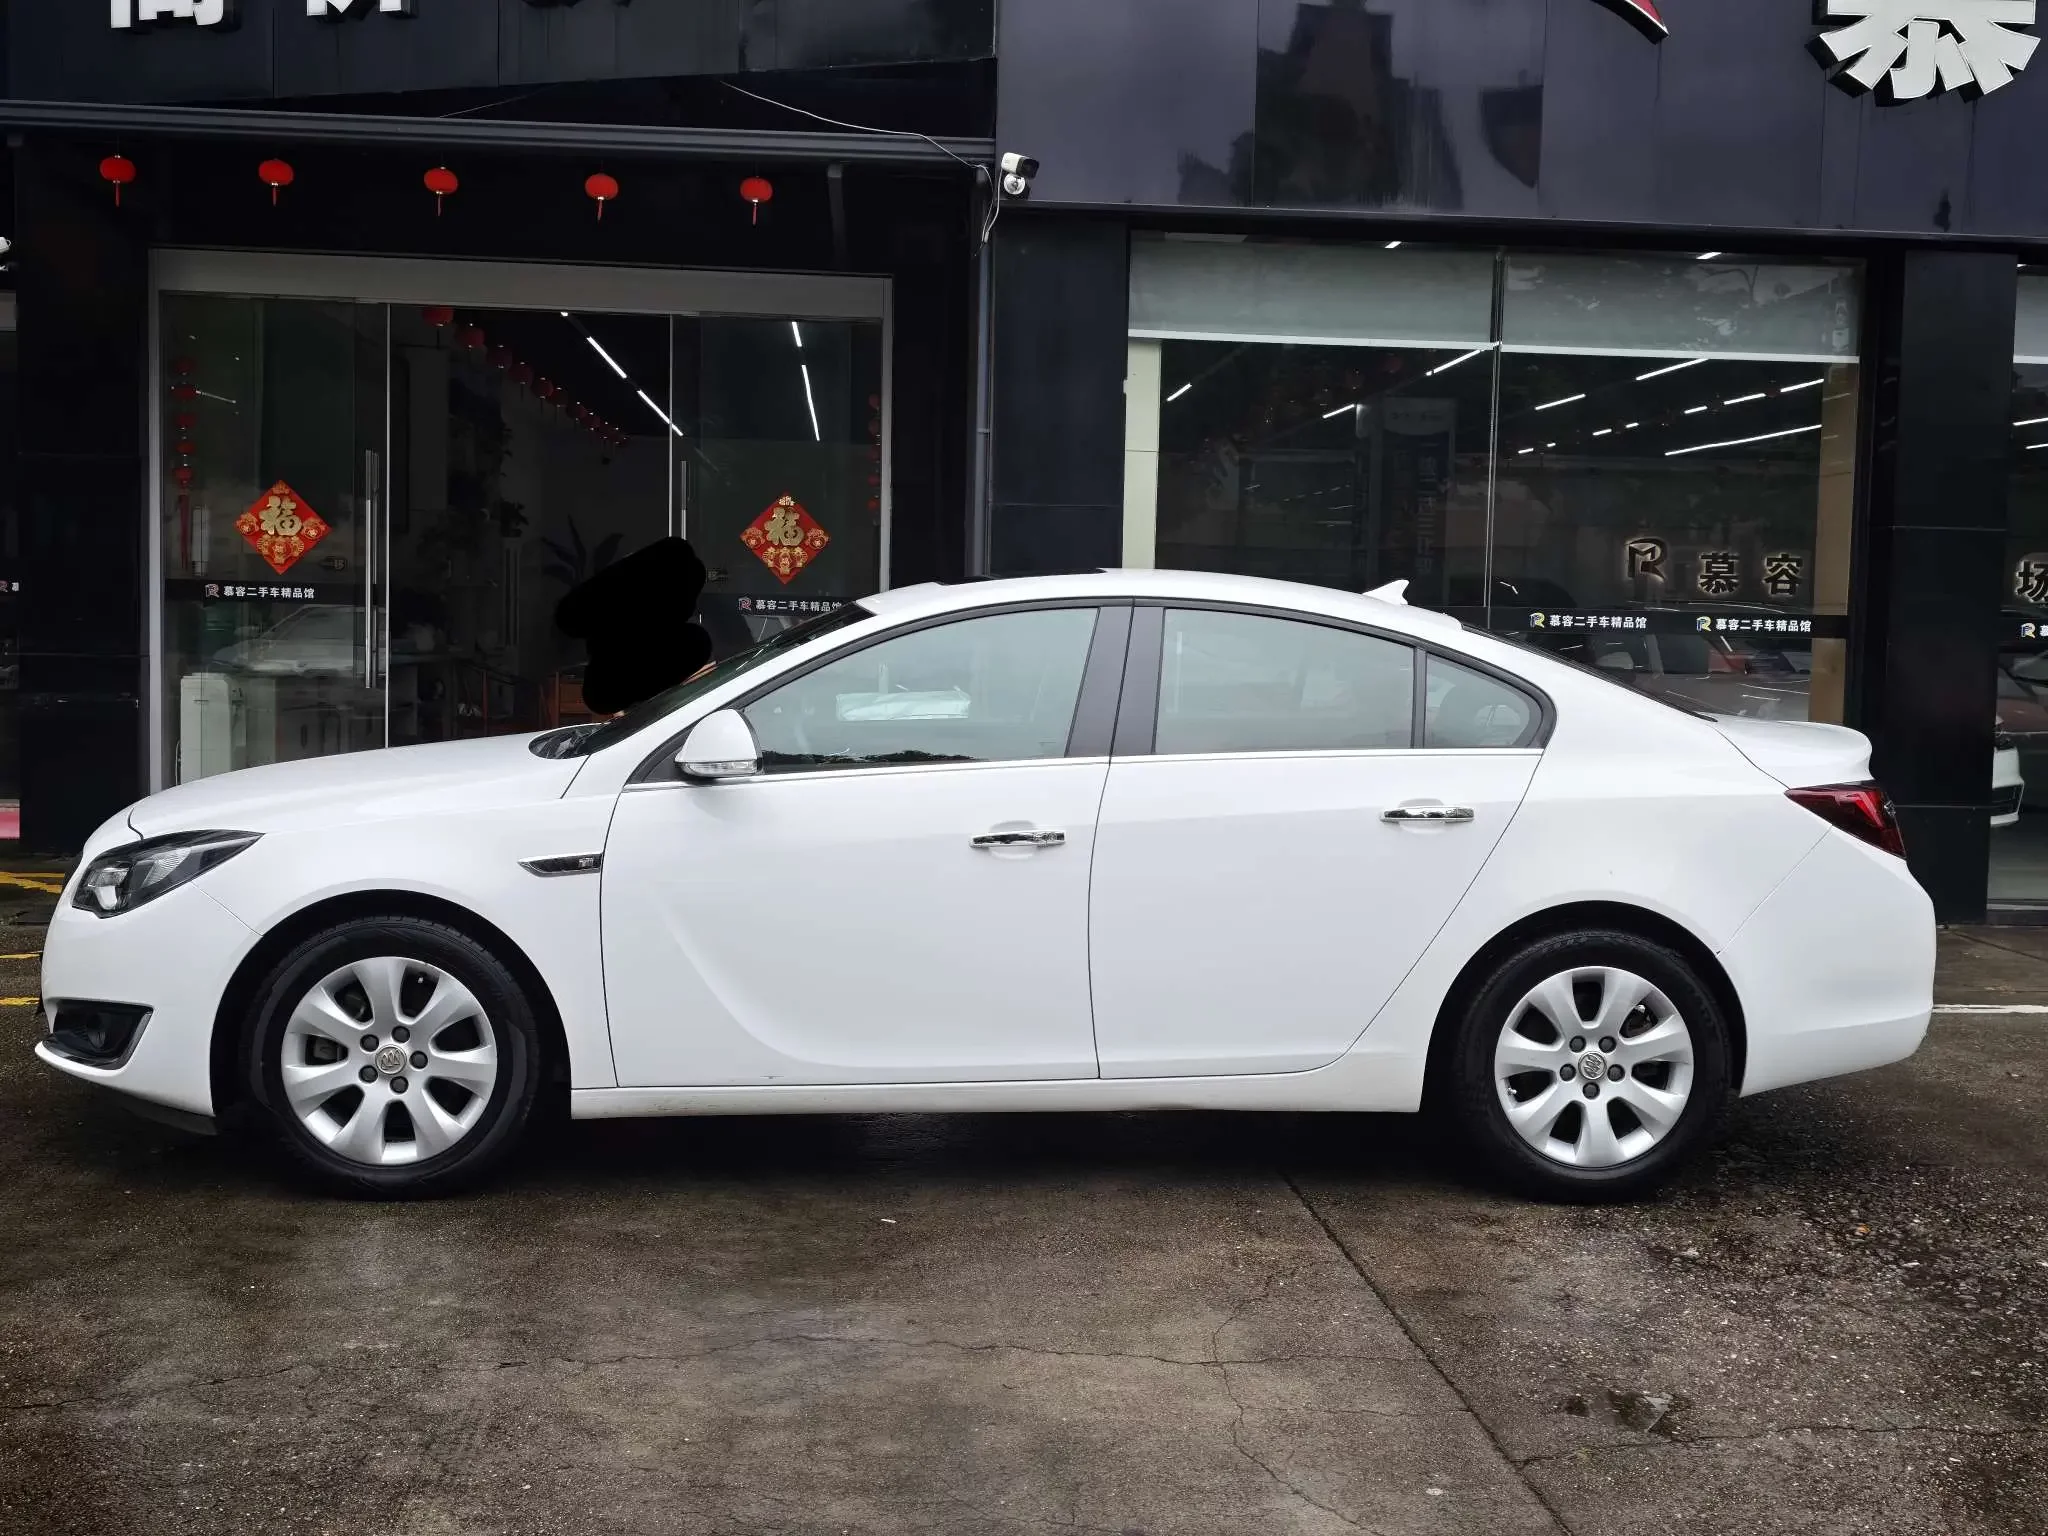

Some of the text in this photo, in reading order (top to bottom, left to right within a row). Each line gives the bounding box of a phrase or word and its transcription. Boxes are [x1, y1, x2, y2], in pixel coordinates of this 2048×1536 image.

[258, 494, 303, 537] 福
[763, 506, 805, 547] 福
[1698, 551, 1803, 595] 慕容
[223, 585, 315, 599] 慕容二手车精品馆
[1549, 614, 1648, 629] 慕容二手车精品馆
[1715, 618, 1812, 632] 慕容二手车精品馆
